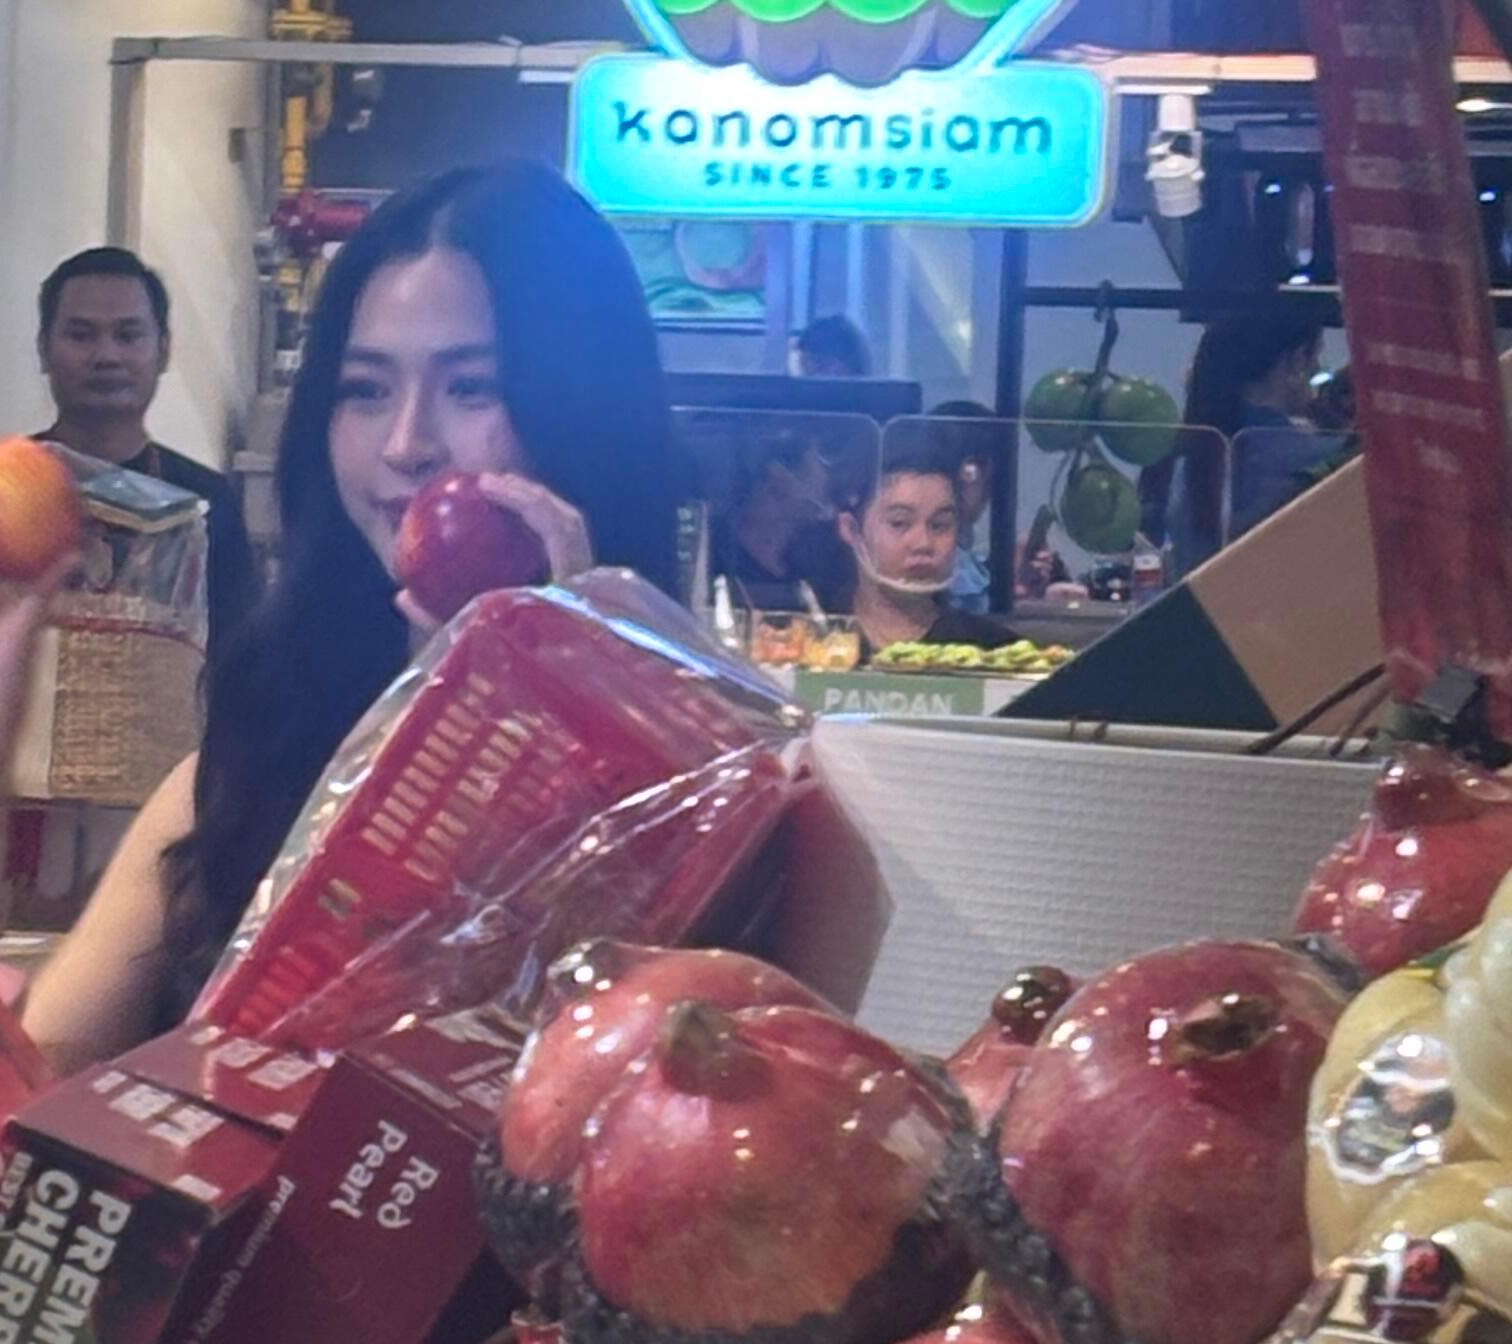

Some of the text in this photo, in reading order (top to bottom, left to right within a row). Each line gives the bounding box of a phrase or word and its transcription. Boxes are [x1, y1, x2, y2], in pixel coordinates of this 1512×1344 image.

[703, 161, 954, 192] SINCE 1975
[823, 686, 954, 718] PANDAN
[328, 1119, 410, 1221] Pearl
[376, 1154, 440, 1231] Red
[237, 1173, 297, 1269] premium
